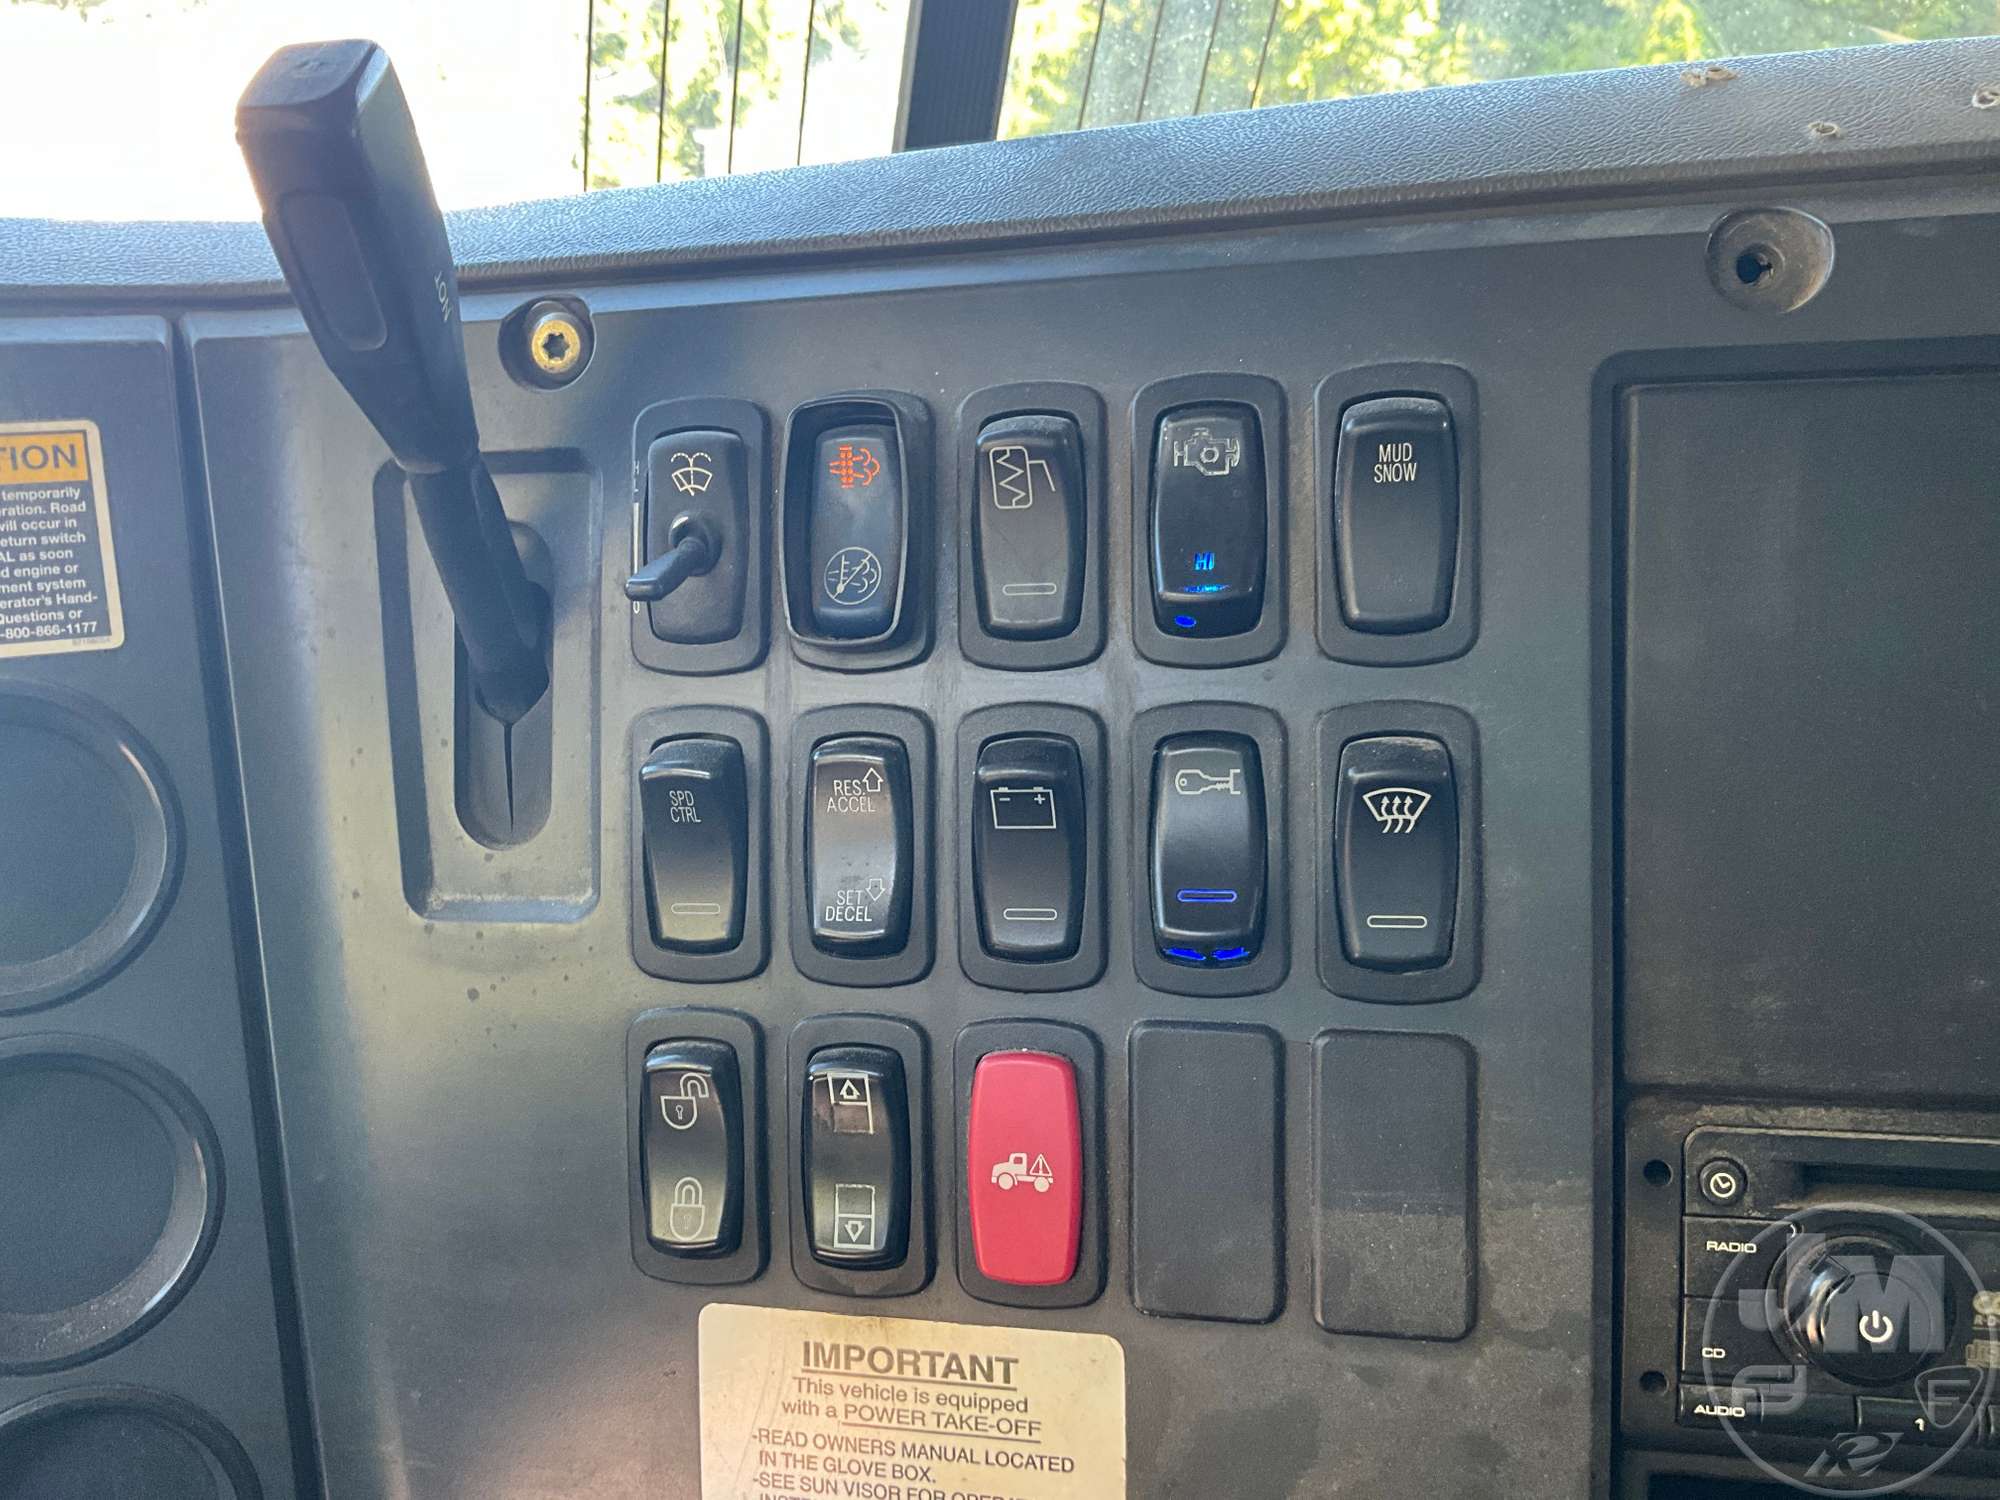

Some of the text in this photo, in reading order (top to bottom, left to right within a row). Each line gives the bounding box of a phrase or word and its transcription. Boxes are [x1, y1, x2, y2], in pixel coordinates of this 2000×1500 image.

[0, 443, 77, 471] ION
[1378, 442, 1413, 462] MUD
[1374, 463, 1417, 483] SNOW
[2, 487, 80, 502] temporarily
[50, 501, 86, 513] Road
[20, 520, 61, 531] occur
[65, 518, 77, 529] in
[40, 532, 86, 545] switch
[19, 551, 36, 562] as
[39, 549, 73, 561] soon
[1194, 551, 1215, 571] HI
[14, 565, 60, 578] engine
[64, 564, 79, 574] or
[37, 579, 86, 593] system
[56, 591, 98, 605] Hand-
[68, 609, 83, 619] or
[669, 790, 694, 807] SPD
[827, 796, 876, 814] ACCEL
[670, 806, 701, 823] CTRL
[836, 889, 863, 907] SET
[825, 905, 872, 922] DECEL
[1706, 1240, 1757, 1254] RADIO
[1702, 1347, 1726, 1359] CD
[801, 1340, 1019, 1386] IMPORTANT
[792, 1376, 1029, 1414] This vehicle is equipped
[781, 1399, 1041, 1437] with a POWER TAKE-OFF
[1693, 1404, 1746, 1418] AUDIO
[1914, 1417, 1926, 1432] 1
[812, 1434, 897, 1457] OWNERS
[901, 1444, 981, 1465] MANUAL
[984, 1450, 1075, 1474] LOCATED
[758, 1449, 937, 1484] IN THE GLOVE BOX.
[799, 1476, 839, 1496] SUN
[841, 1481, 901, 1500] VISOR
